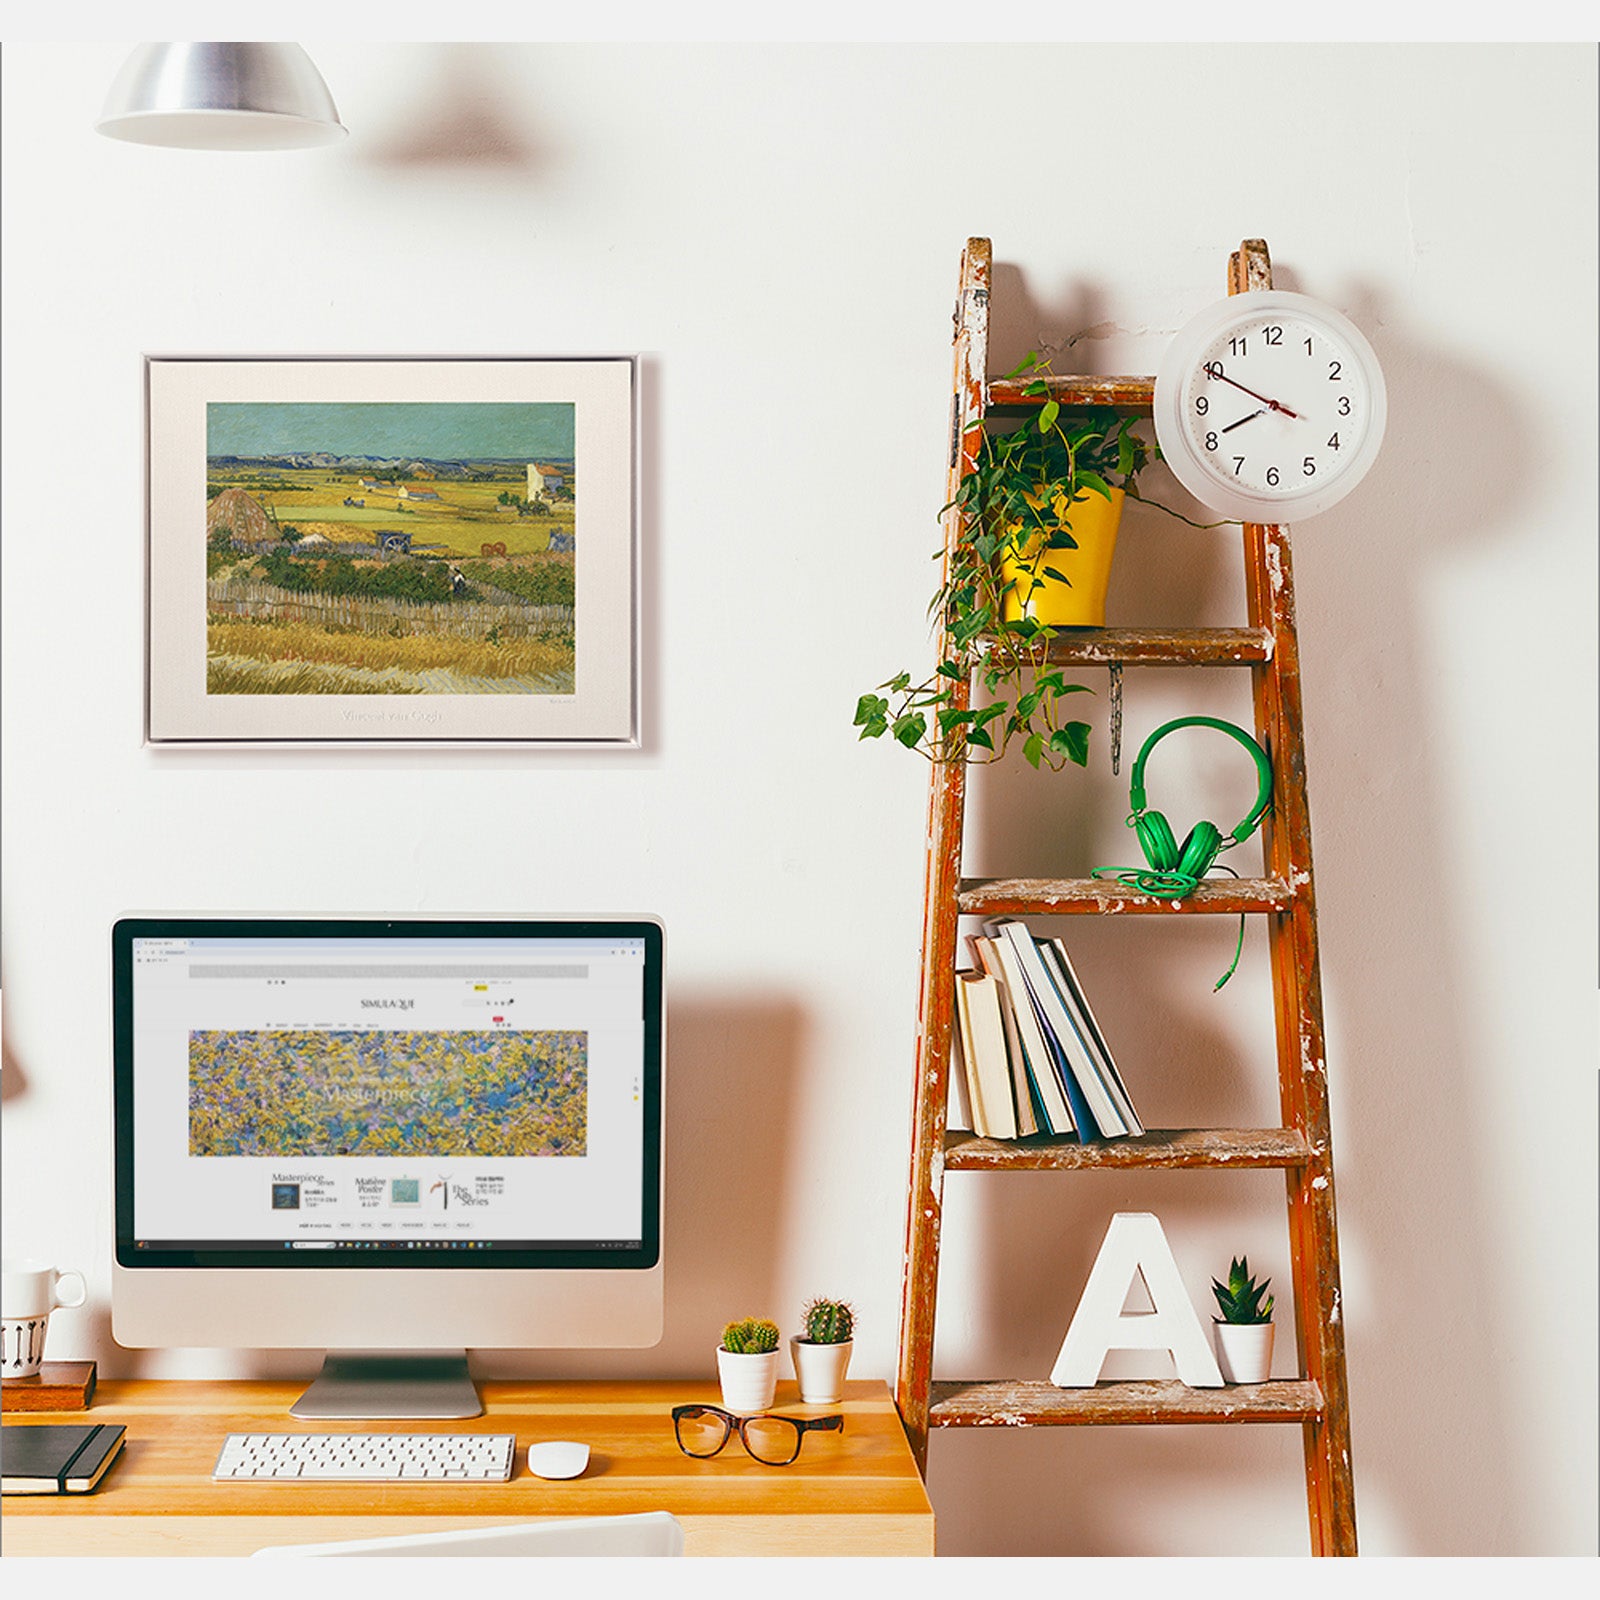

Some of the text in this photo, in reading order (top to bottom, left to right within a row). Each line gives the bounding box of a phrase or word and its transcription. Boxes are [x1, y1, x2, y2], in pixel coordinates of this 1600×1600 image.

[1262, 326, 1283, 346] 12
[1228, 337, 1248, 356] 11
[1303, 337, 1313, 356] 1
[1204, 361, 1224, 381] 10
[1328, 361, 1342, 381] 2
[1195, 396, 1209, 416] 9
[1338, 396, 1351, 416] 3
[1205, 431, 1219, 452] 8
[1327, 432, 1341, 451] 4
[1232, 456, 1246, 476] 7
[1302, 456, 1317, 477] 5
[1266, 466, 1280, 487] 6
[322, 1086, 431, 1107] Masterpiece
[272, 1172, 325, 1185] Masterpiece
[1050, 1212, 1225, 1389] A
